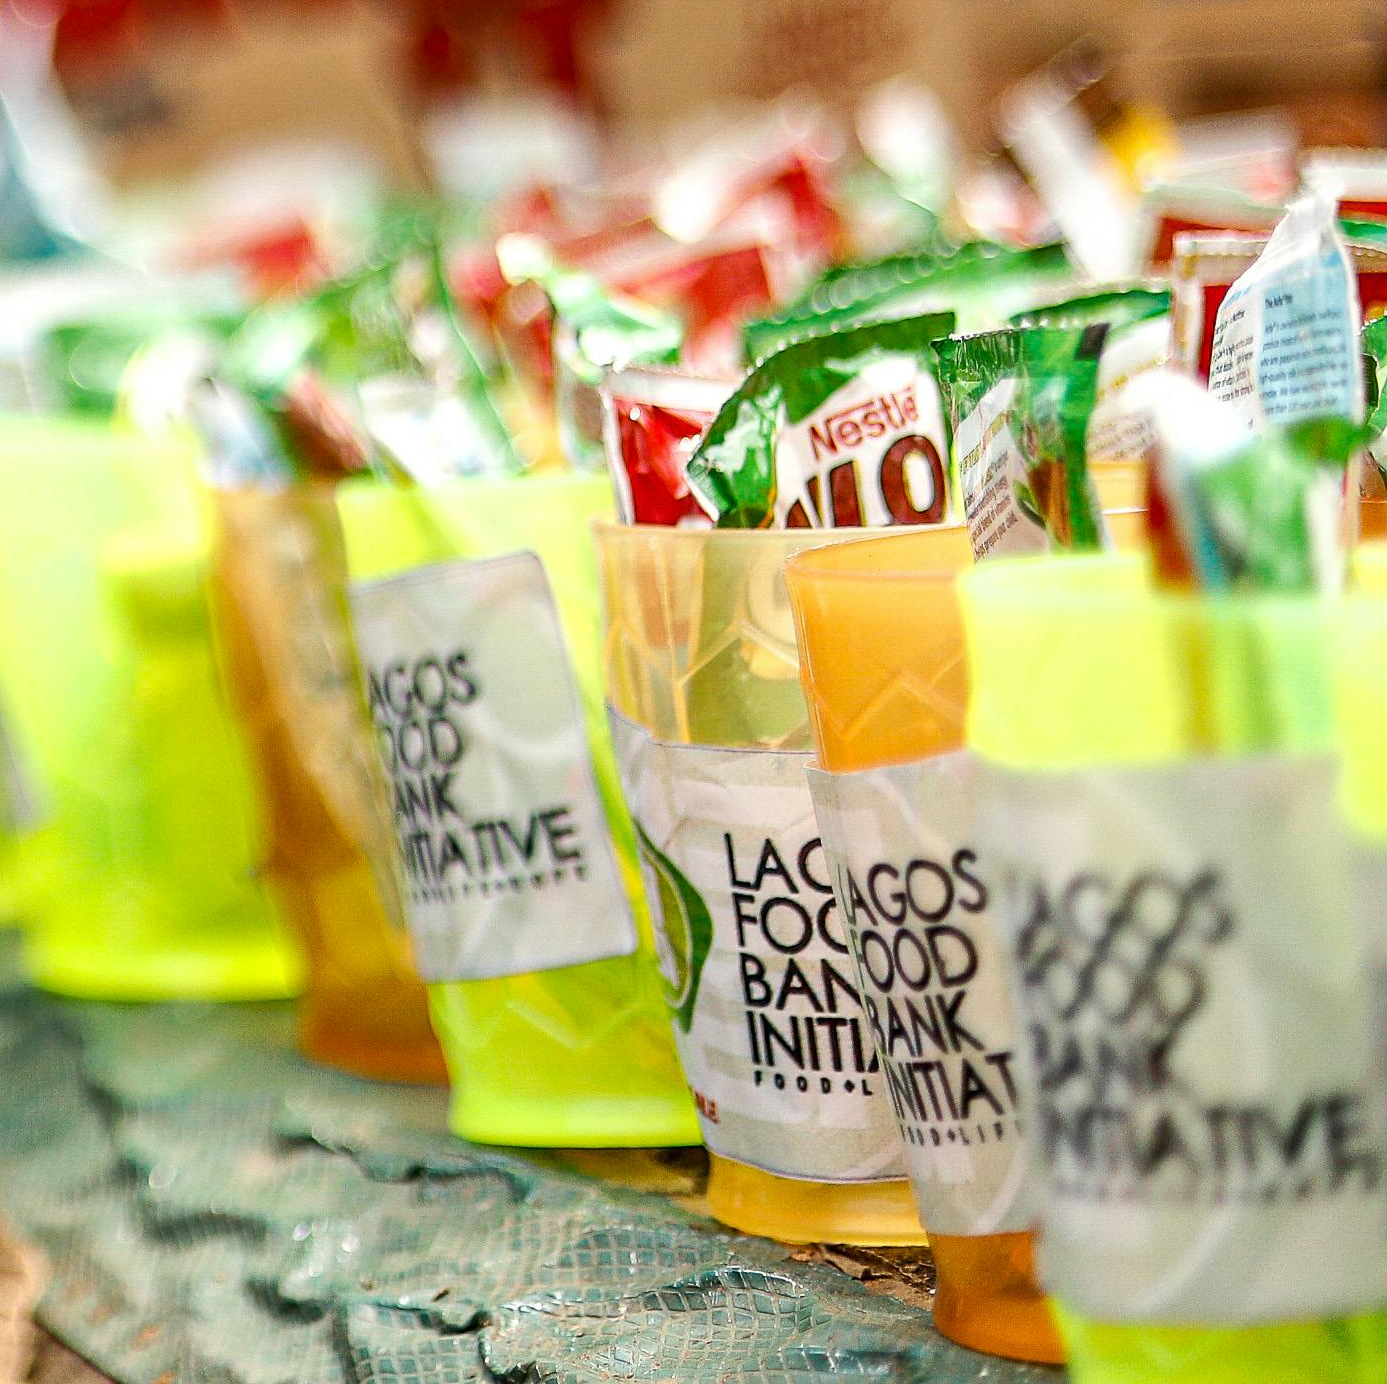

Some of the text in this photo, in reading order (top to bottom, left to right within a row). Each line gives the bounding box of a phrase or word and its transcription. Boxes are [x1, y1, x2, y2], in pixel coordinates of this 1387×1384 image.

[836, 848, 988, 924] LAGOS
[848, 924, 979, 994] FOOD
[864, 989, 986, 1058] BANK
